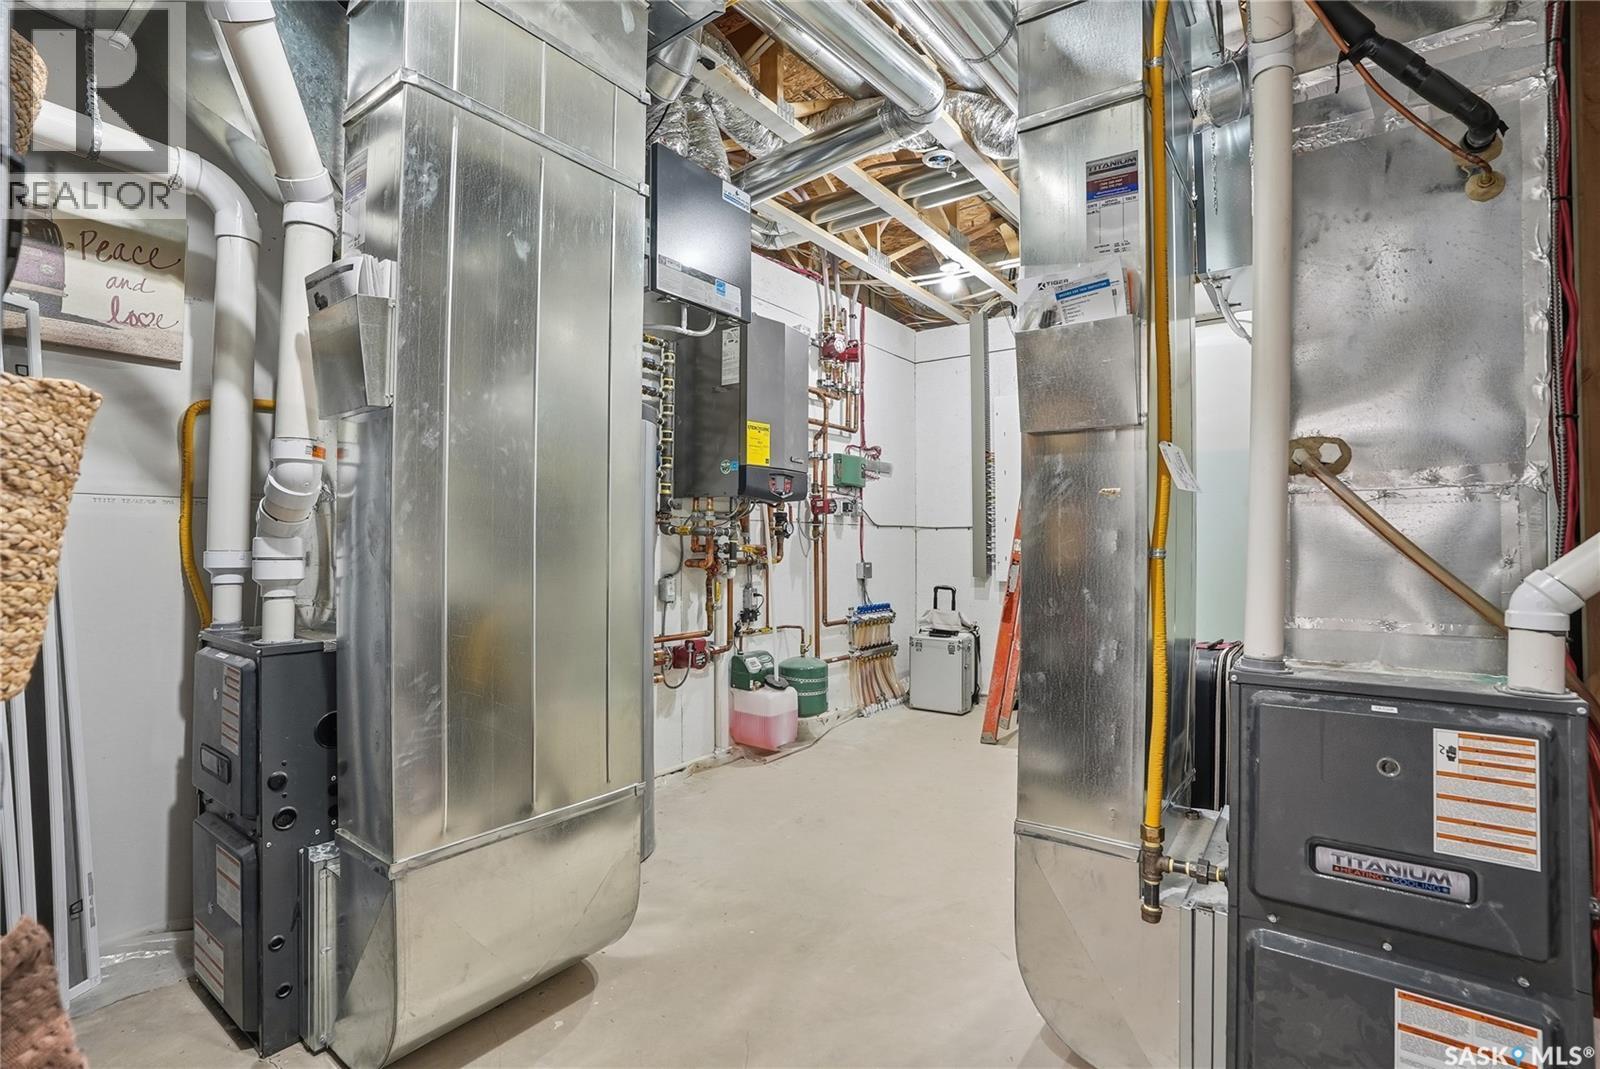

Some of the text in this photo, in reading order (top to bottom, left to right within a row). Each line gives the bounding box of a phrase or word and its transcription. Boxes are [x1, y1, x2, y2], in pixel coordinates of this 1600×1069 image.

[1088, 157, 1137, 171] TITANIUM
[80, 230, 181, 270] Peace
[105, 276, 156, 294] and
[1046, 279, 1069, 287] TIGER
[1331, 853, 1453, 888] TITANIUM
[1339, 865, 1441, 893] HEATING COOLING
